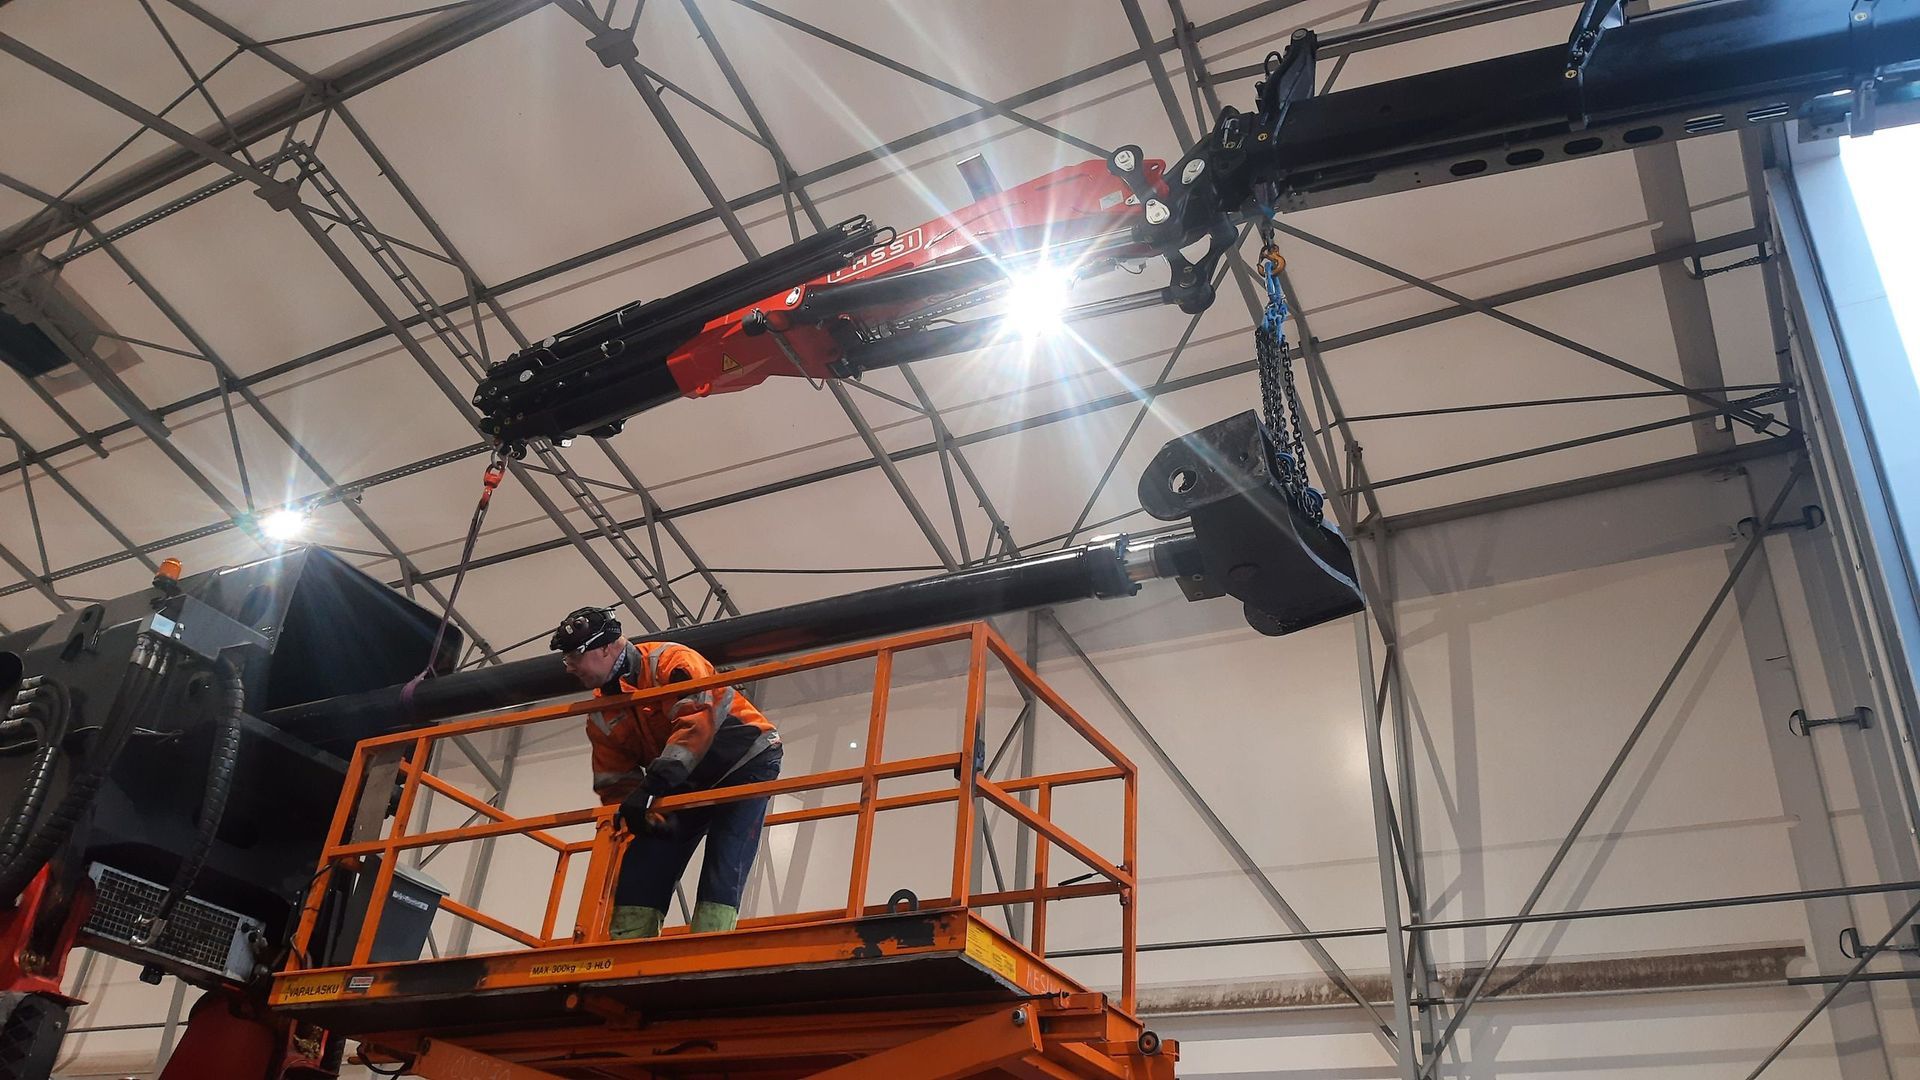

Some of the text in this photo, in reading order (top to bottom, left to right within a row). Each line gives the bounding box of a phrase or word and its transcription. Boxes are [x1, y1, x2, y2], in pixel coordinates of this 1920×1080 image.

[835, 234, 914, 277] ASSI
[532, 966, 549, 975] MAX
[289, 984, 339, 997] VARALASKU
